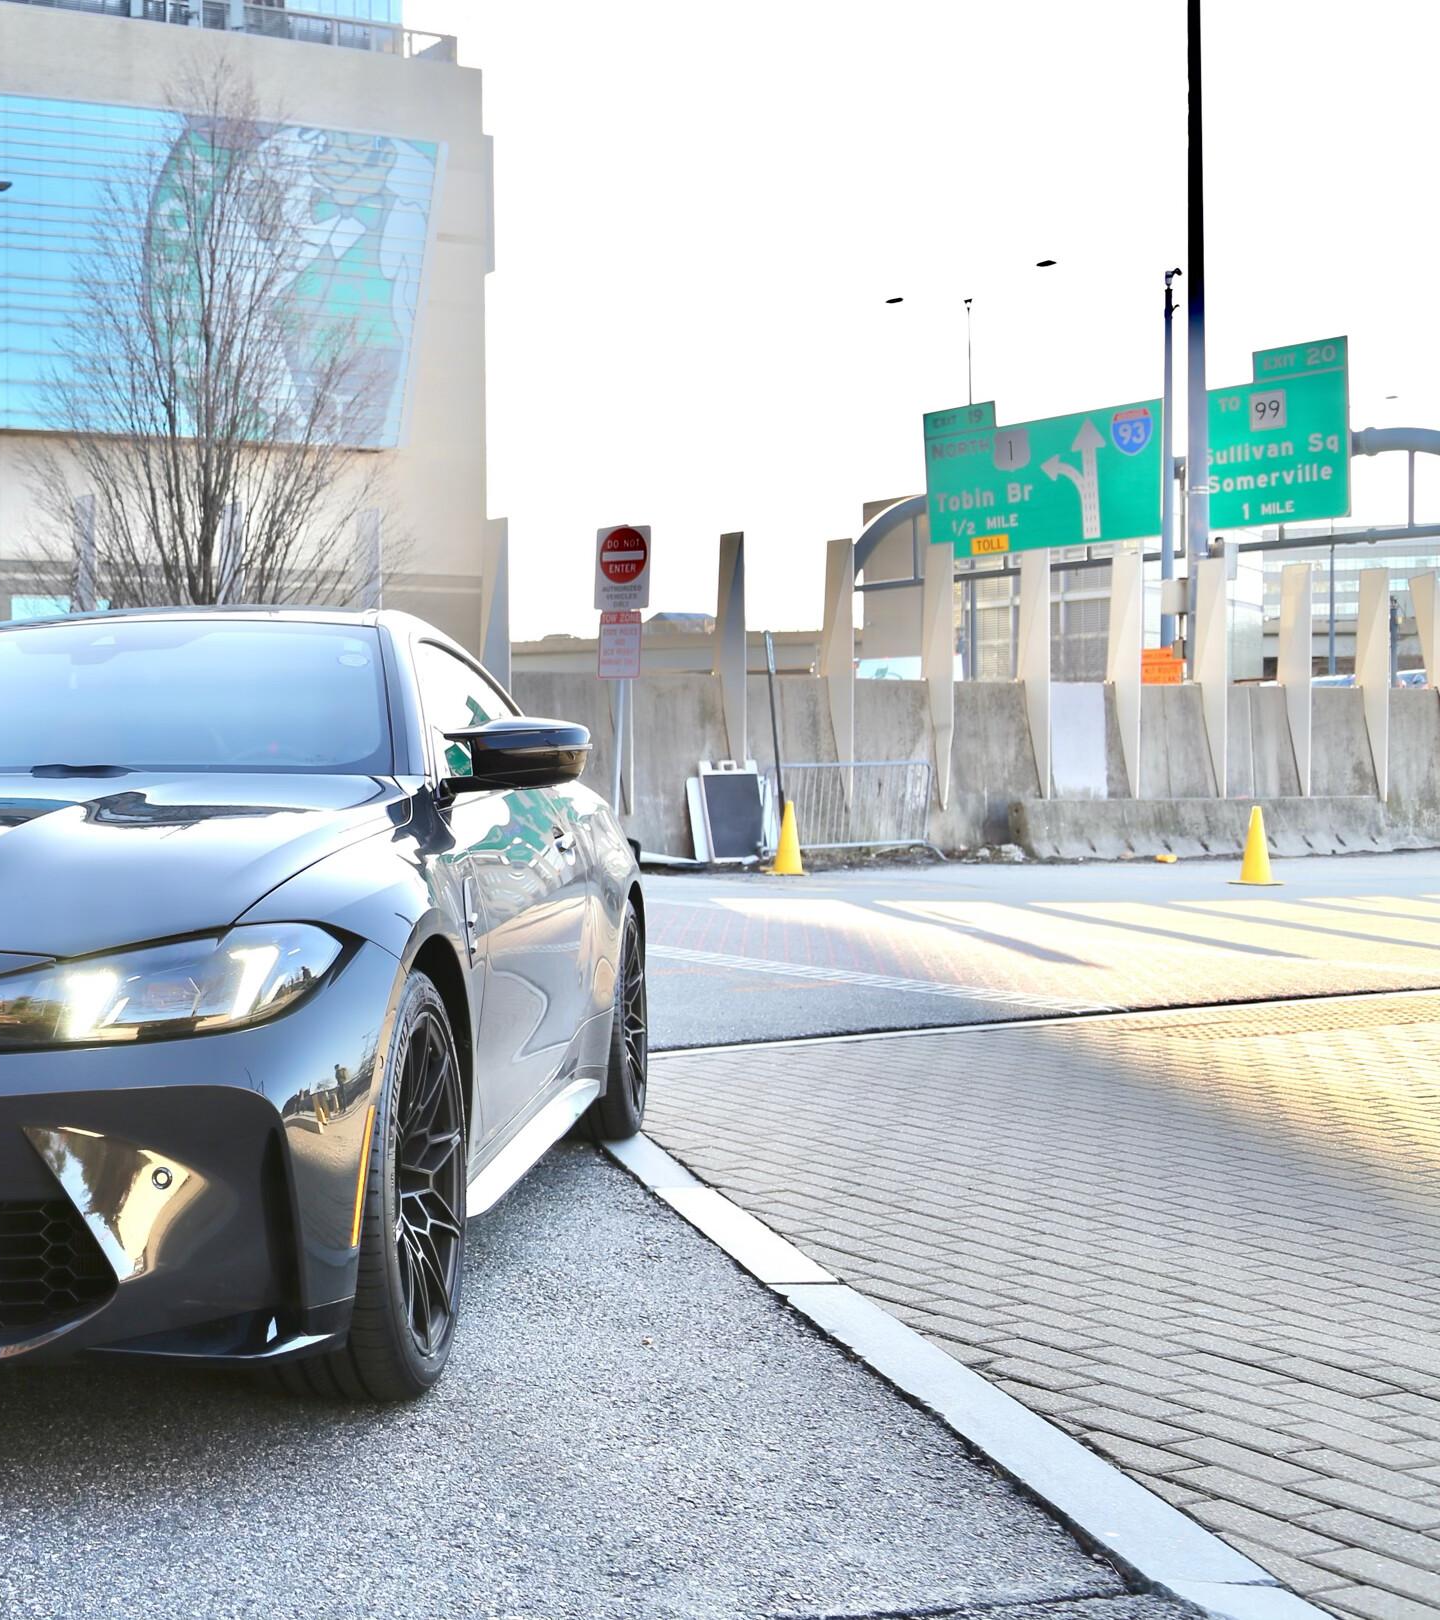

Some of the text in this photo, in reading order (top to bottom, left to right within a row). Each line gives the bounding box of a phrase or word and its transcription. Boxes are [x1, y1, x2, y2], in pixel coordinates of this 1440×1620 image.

[1263, 345, 1336, 371] EXIT 20
[933, 409, 983, 428] EXIT 19
[1218, 397, 1280, 420] TO 99
[1118, 422, 1146, 445] 93
[931, 437, 990, 460] NORTH
[1206, 433, 1339, 466] Sullivan Sq
[1207, 463, 1333, 494] Somerville
[936, 482, 1033, 513] Tobin Br
[1242, 500, 1295, 520] 1 MILE
[952, 513, 1019, 537] 1/2 MILE
[607, 539, 640, 549] DO NOT
[976, 538, 1005, 552] TOLL
[609, 563, 637, 574] ENTER
[602, 612, 641, 624] TOW ZONE
